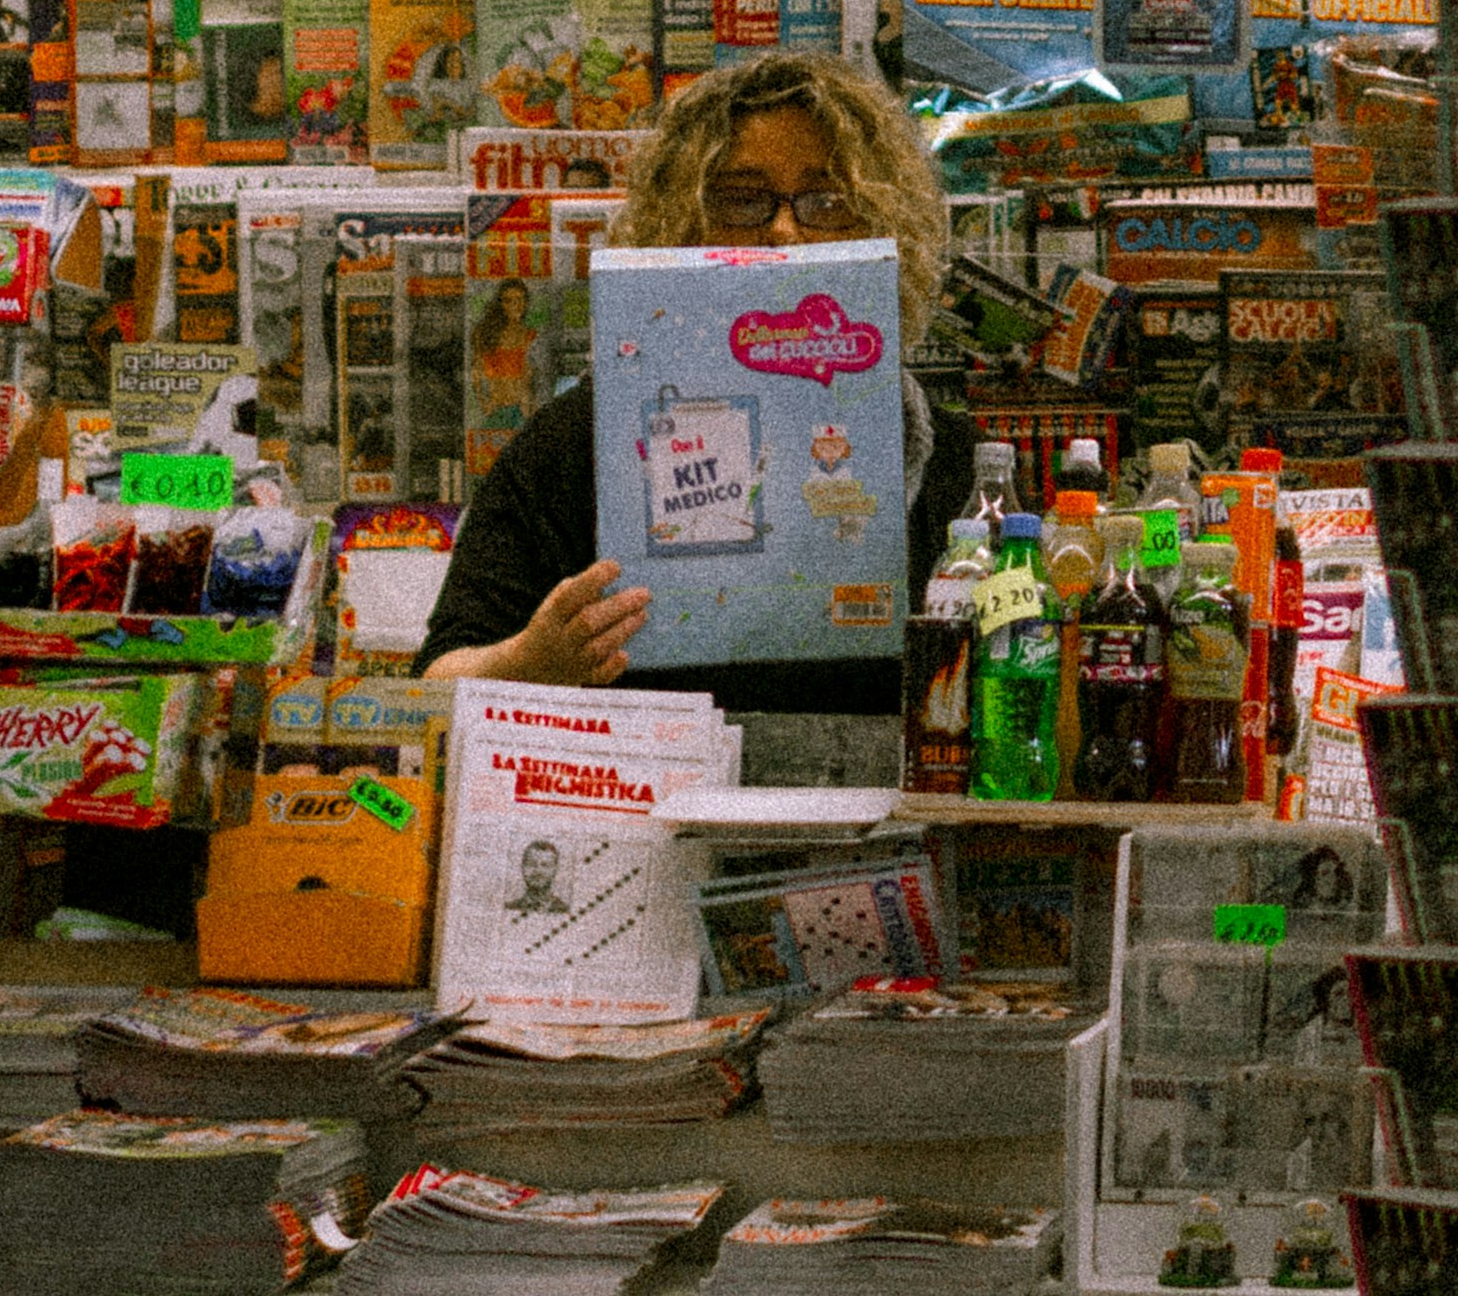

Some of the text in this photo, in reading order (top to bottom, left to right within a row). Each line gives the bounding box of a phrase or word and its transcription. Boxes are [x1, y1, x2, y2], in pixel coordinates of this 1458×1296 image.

[1114, 217, 1262, 255] CALCIO
[1229, 299, 1332, 321] SCUOLA
[1229, 318, 1317, 343] CALCIO
[672, 457, 720, 490] KIT
[663, 480, 745, 515] MEDICO
[512, 709, 612, 735] SETTIMANA
[515, 771, 656, 804] ENIGMISTICA
[291, 797, 353, 817] BIC
